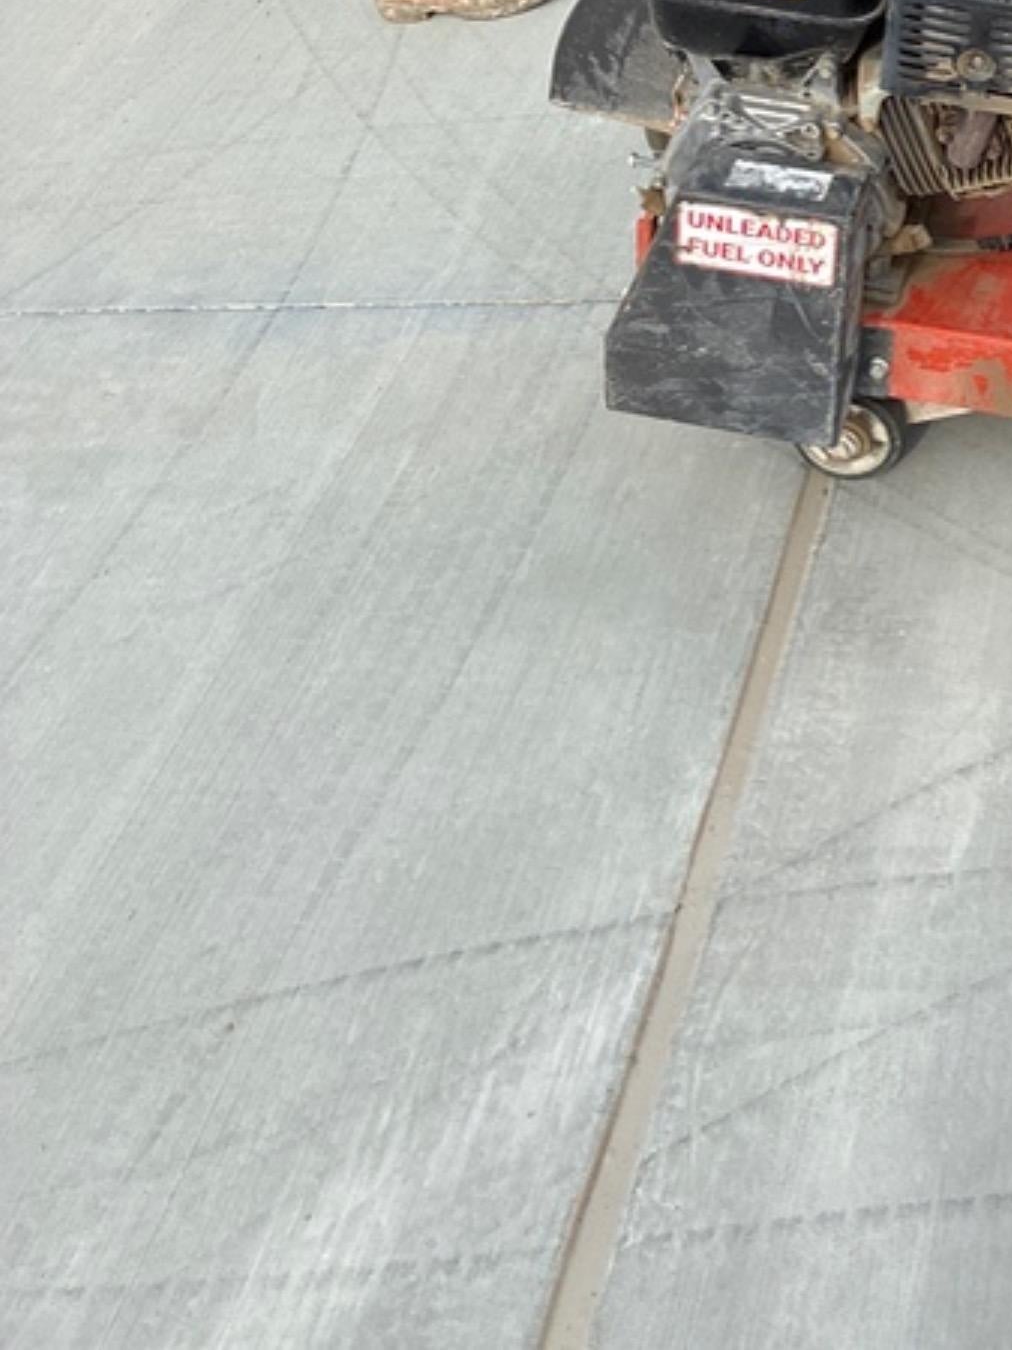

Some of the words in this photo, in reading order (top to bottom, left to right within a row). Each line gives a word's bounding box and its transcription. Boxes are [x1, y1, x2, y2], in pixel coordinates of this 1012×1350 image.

[687, 210, 826, 250] UNLEADED
[686, 236, 750, 264] FUEL
[758, 249, 826, 276] ONLY
